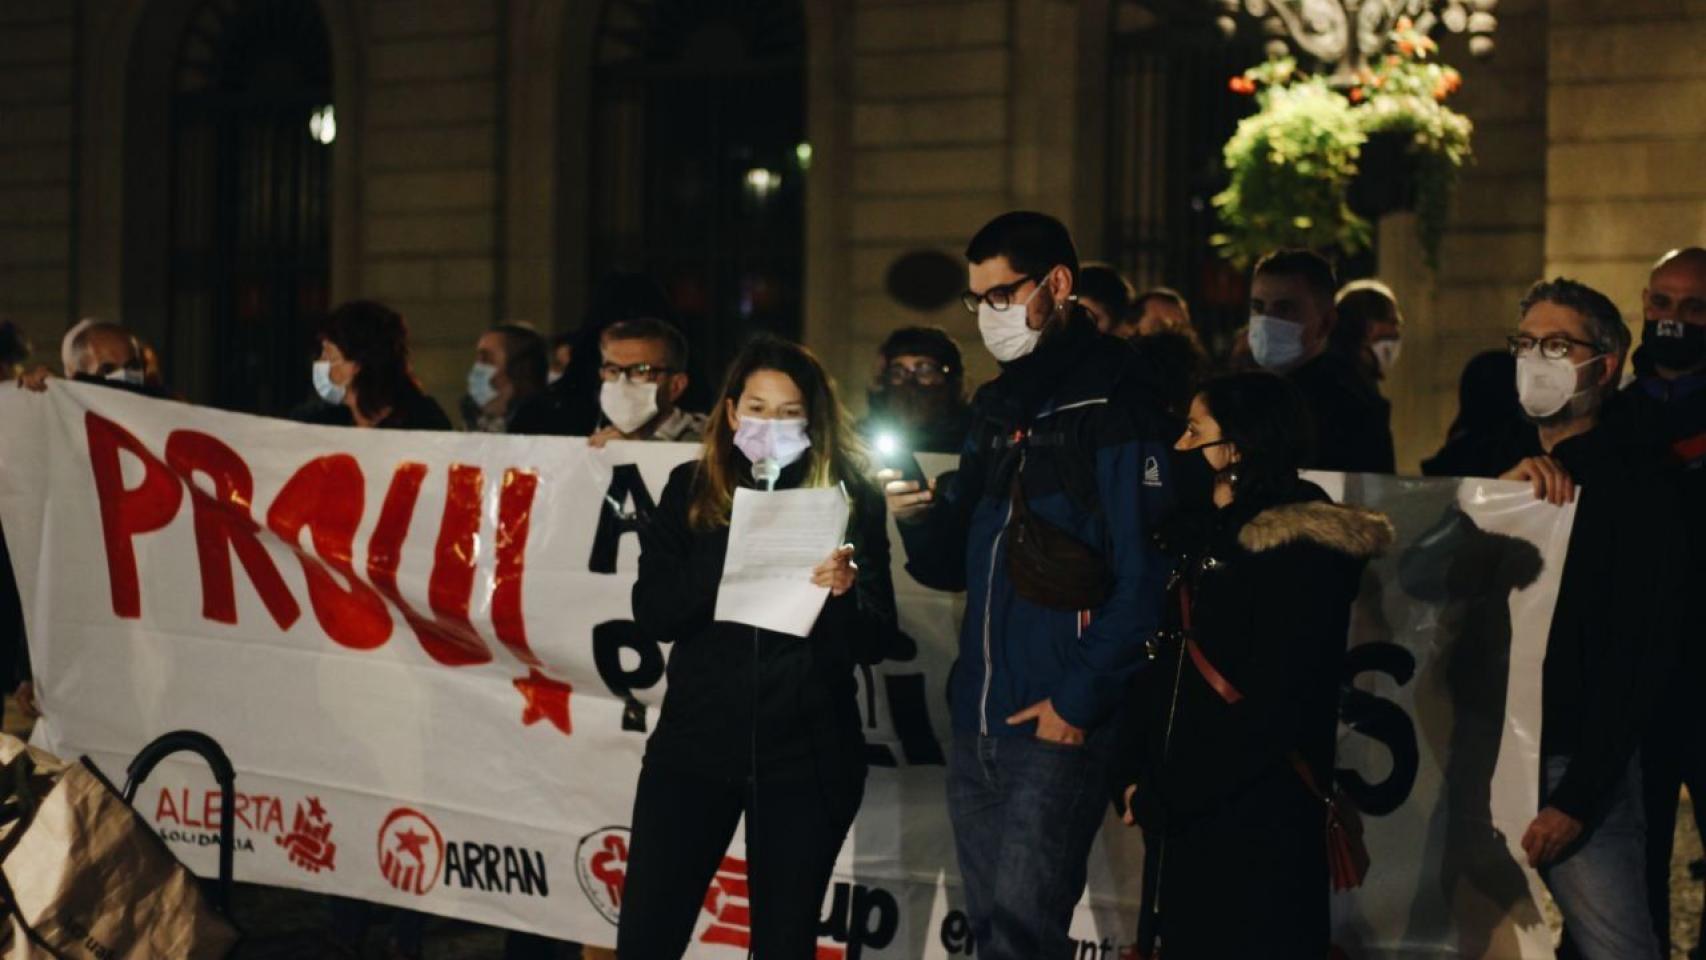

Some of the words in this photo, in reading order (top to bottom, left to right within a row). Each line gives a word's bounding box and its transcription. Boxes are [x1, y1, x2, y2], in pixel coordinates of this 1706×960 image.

[155, 787, 284, 833] ALERTA
[160, 828, 255, 853] SOLIDAIA
[444, 841, 549, 897] ARRAN
[815, 881, 899, 960] up
